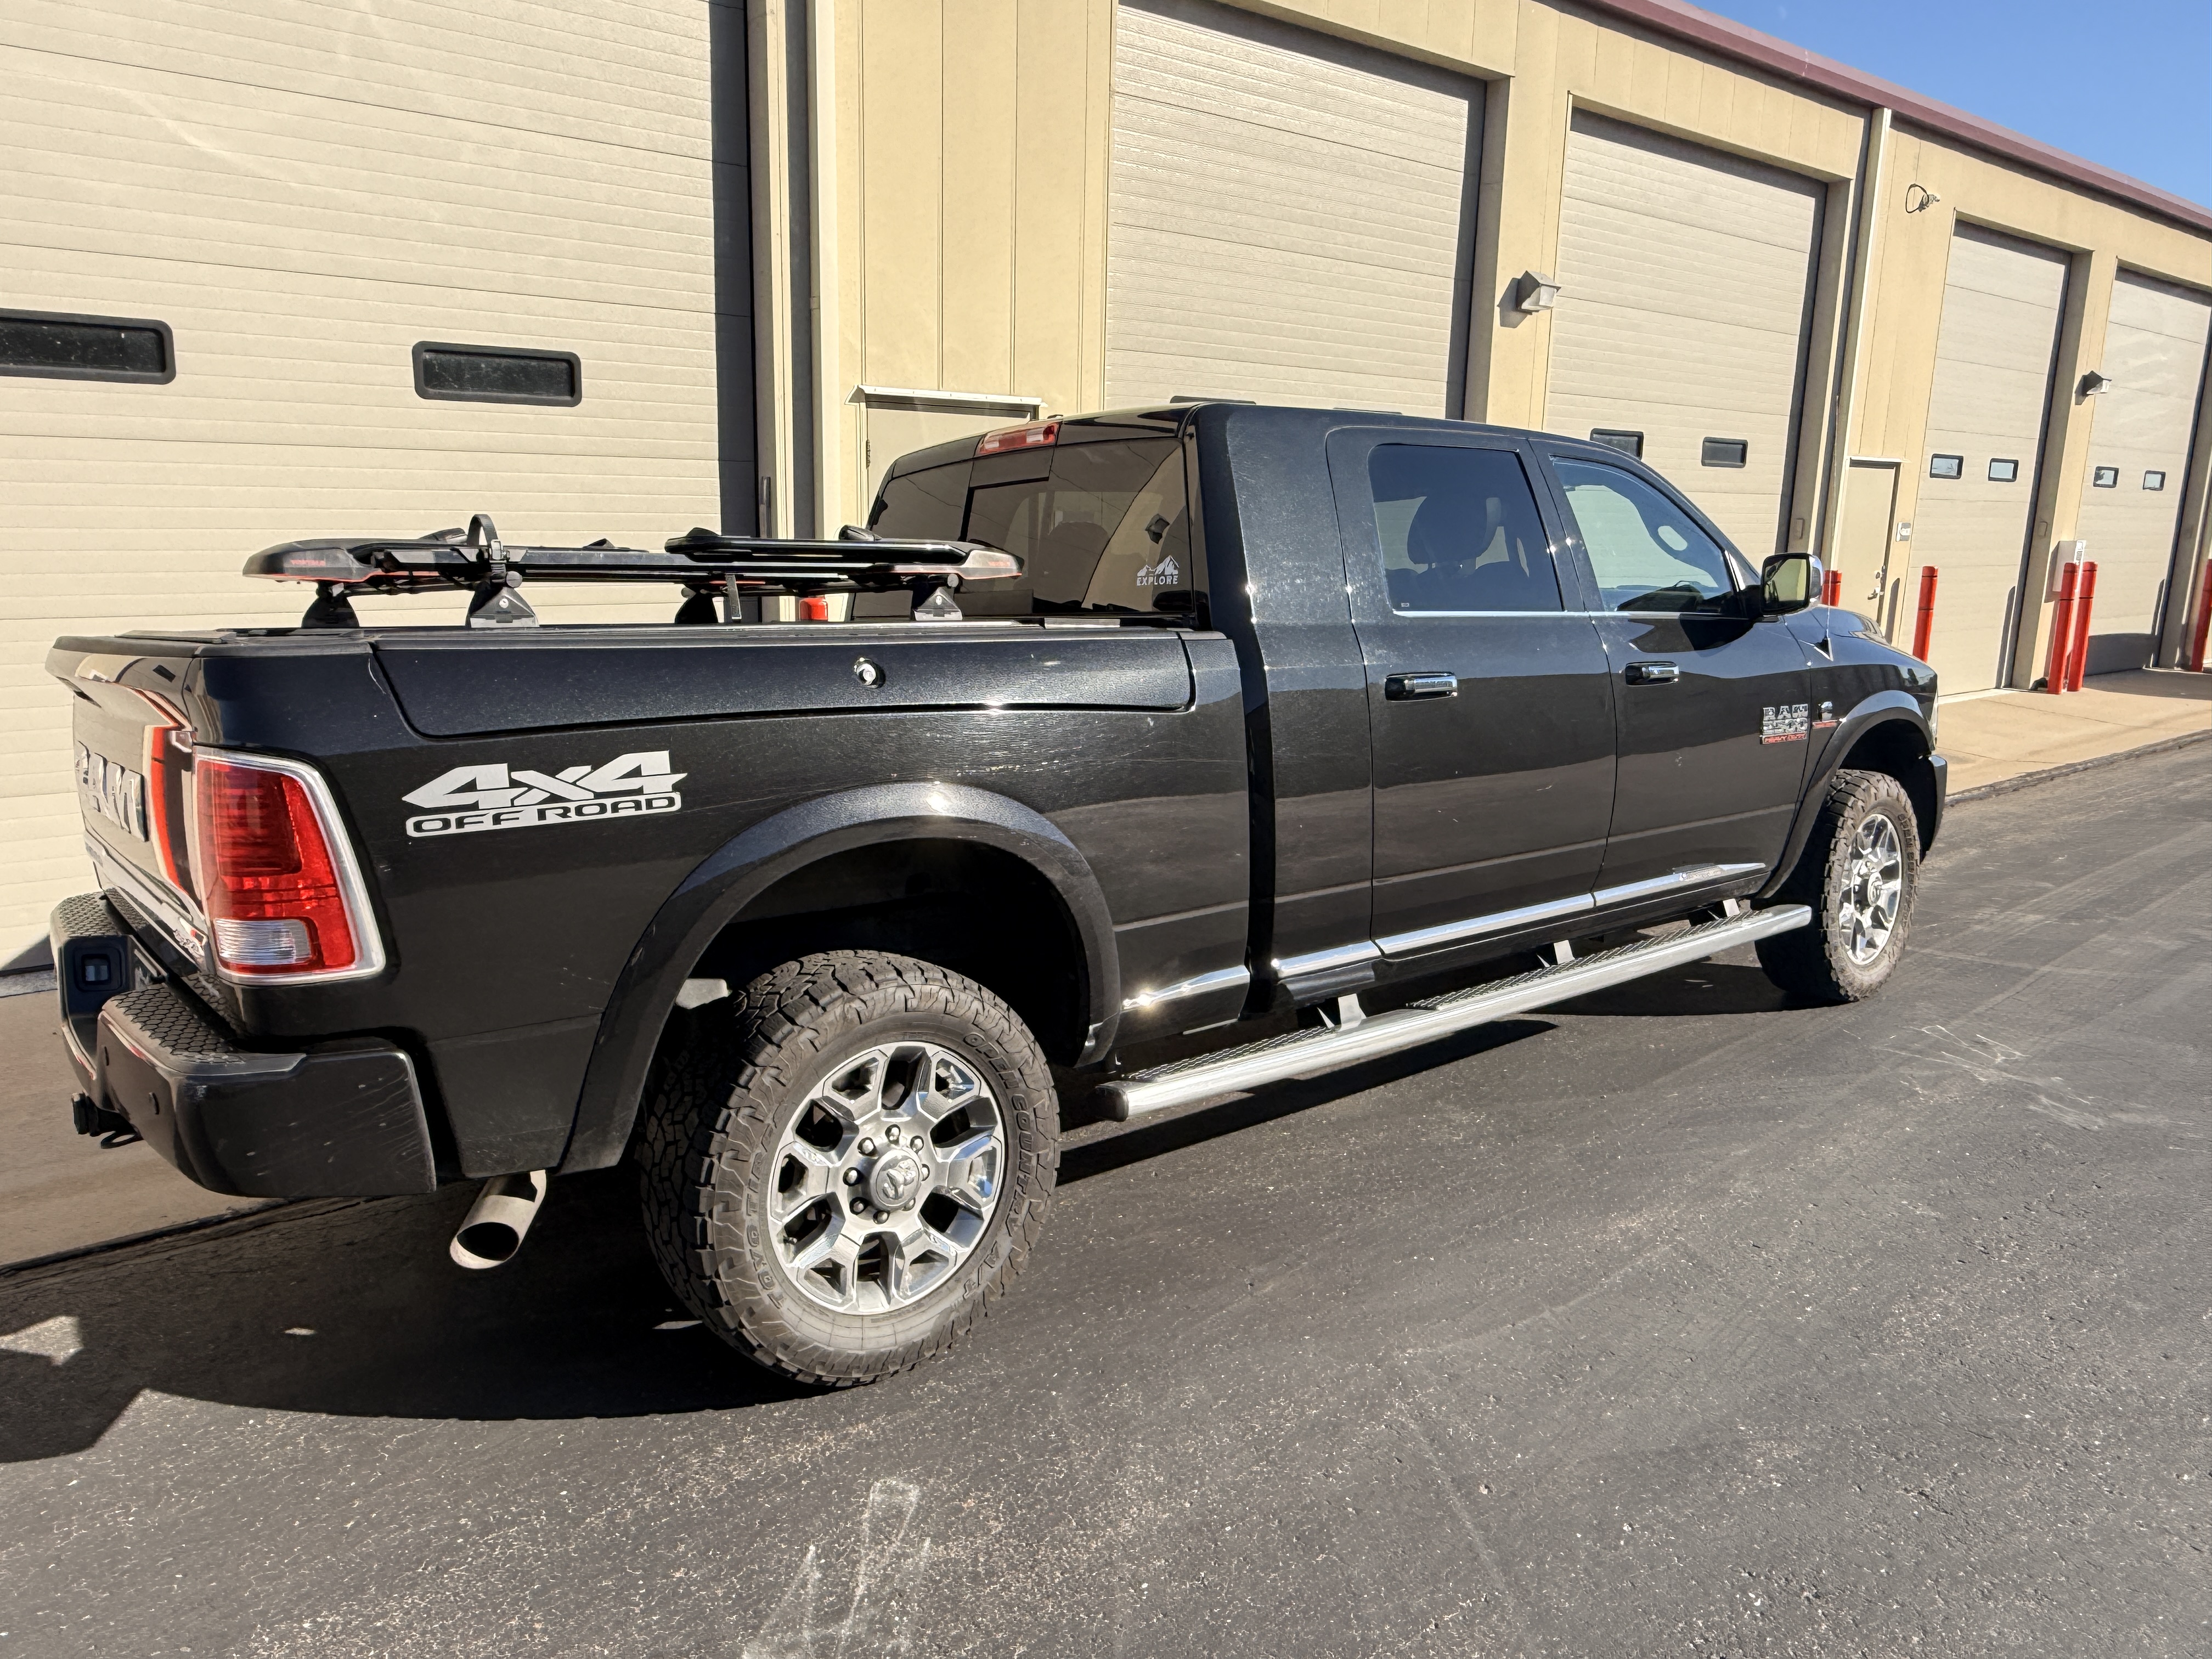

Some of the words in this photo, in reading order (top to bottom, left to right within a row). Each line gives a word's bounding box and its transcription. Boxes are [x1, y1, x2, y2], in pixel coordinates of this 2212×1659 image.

[1136, 575, 1178, 586] EXPLORE
[1763, 704, 1808, 720] RAM
[402, 749, 688, 810] 4x4
[412, 810, 525, 833] OFF
[537, 795, 676, 822] ROAD
[963, 1032, 1019, 1090] OPEN
[747, 1224, 786, 1309] TOYO
